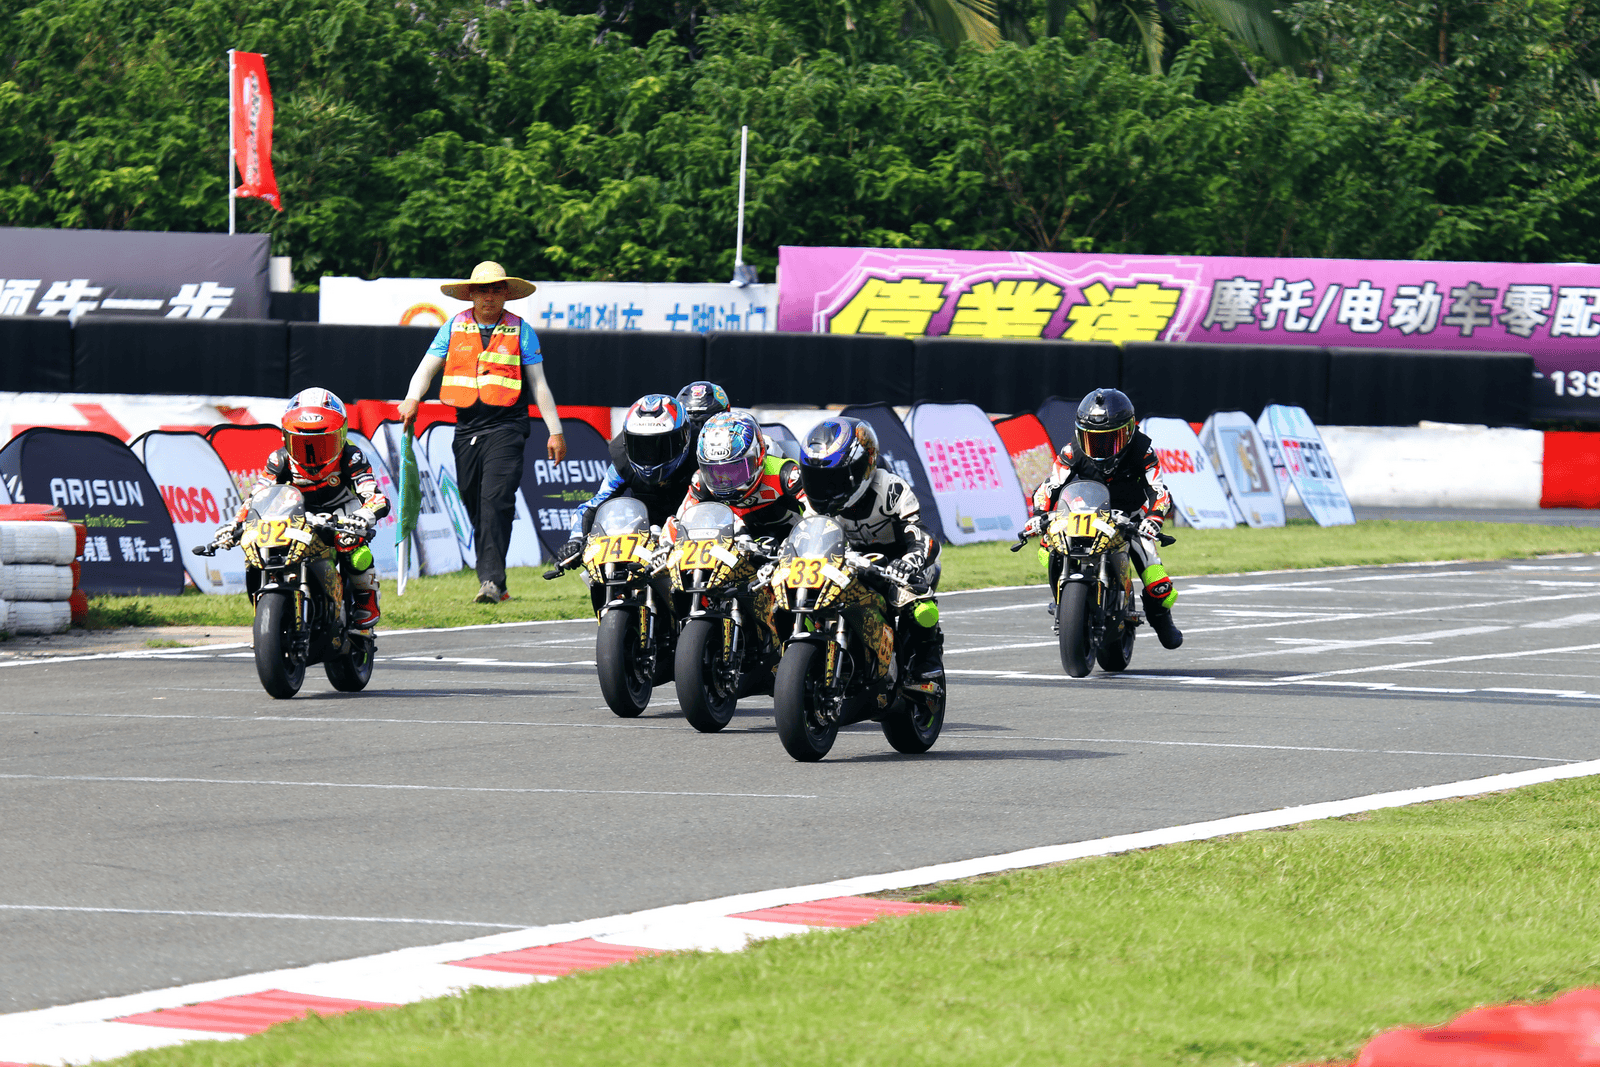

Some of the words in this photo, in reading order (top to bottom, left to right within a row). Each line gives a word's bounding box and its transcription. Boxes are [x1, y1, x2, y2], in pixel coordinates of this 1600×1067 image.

[1550, 370, 1600, 397] 139
[534, 459, 607, 485] ARISUN
[50, 477, 145, 509] ARISUN
[159, 485, 220, 524] KOSO
[259, 521, 287, 544] 92
[1073, 514, 1091, 535] 11
[600, 537, 638, 562] 747
[685, 541, 714, 565] 26
[792, 560, 822, 586] 33
